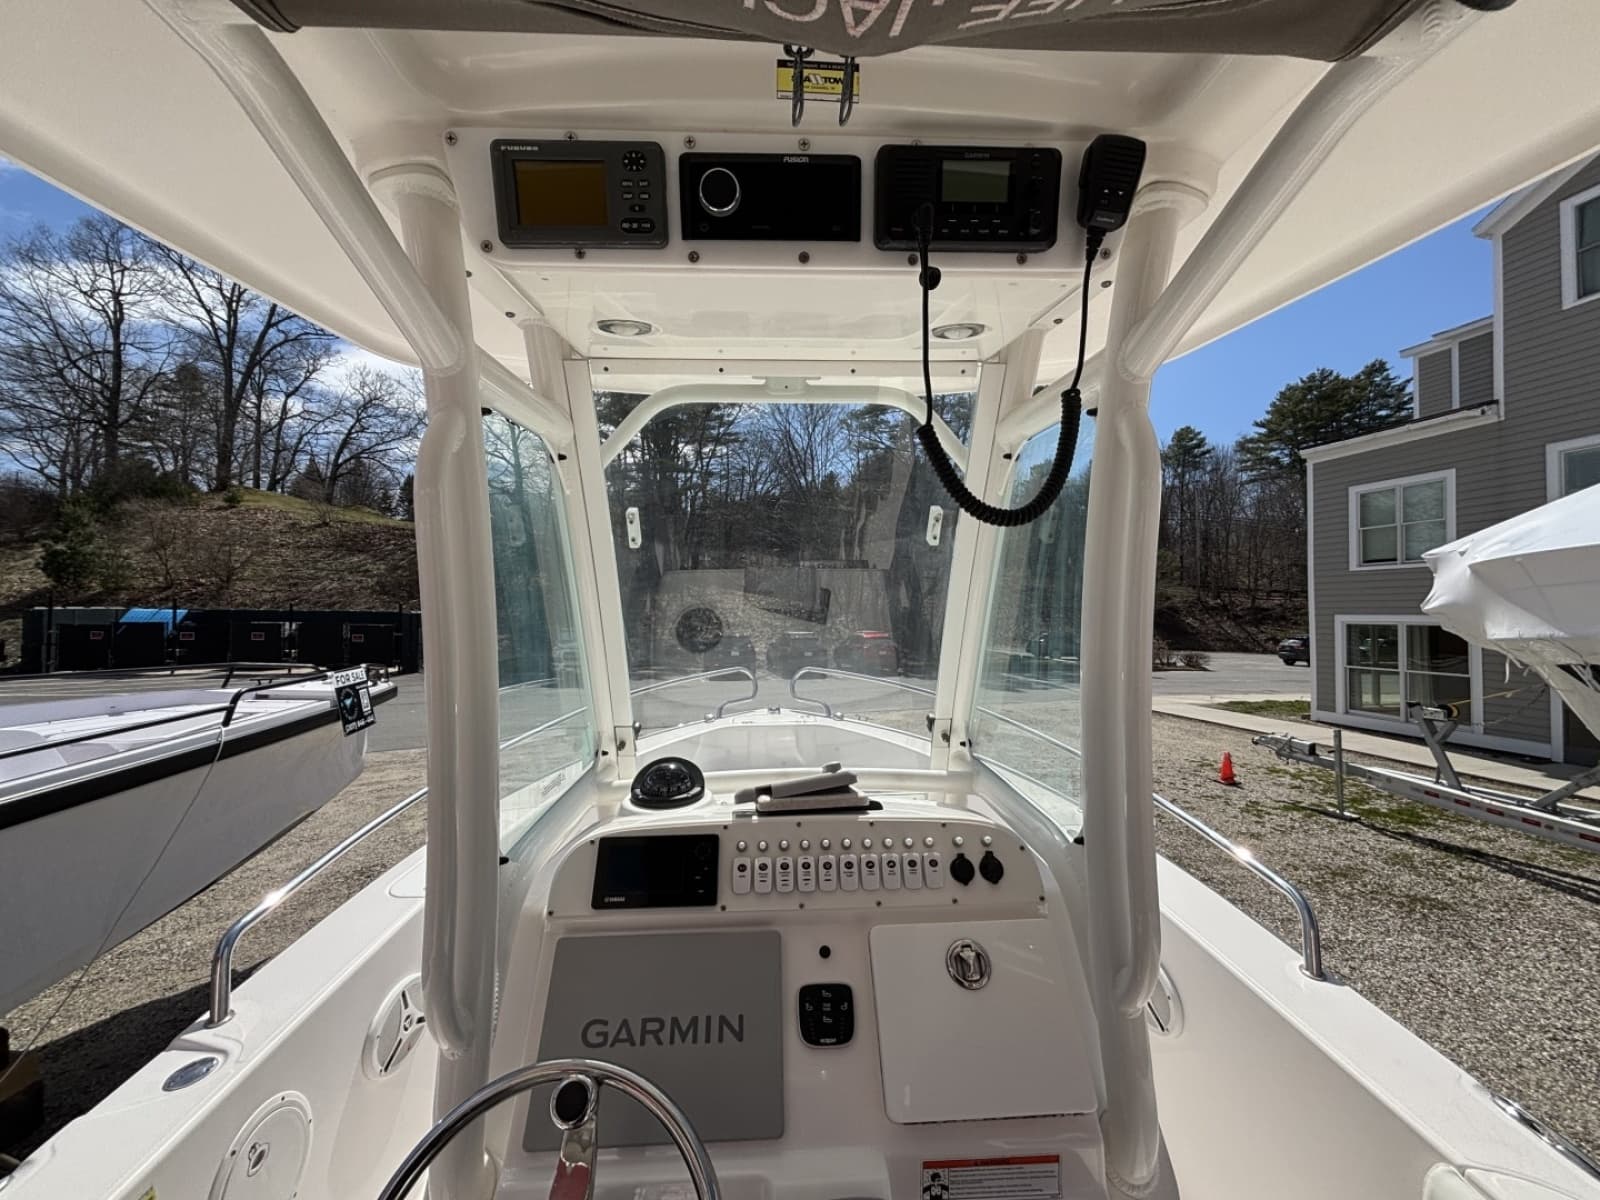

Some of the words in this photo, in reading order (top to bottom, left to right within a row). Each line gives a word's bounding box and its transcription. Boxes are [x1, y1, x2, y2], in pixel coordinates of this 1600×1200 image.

[335, 673, 350, 685] FOR
[351, 670, 366, 682] SALE
[580, 1014, 745, 1048] GARMIN
